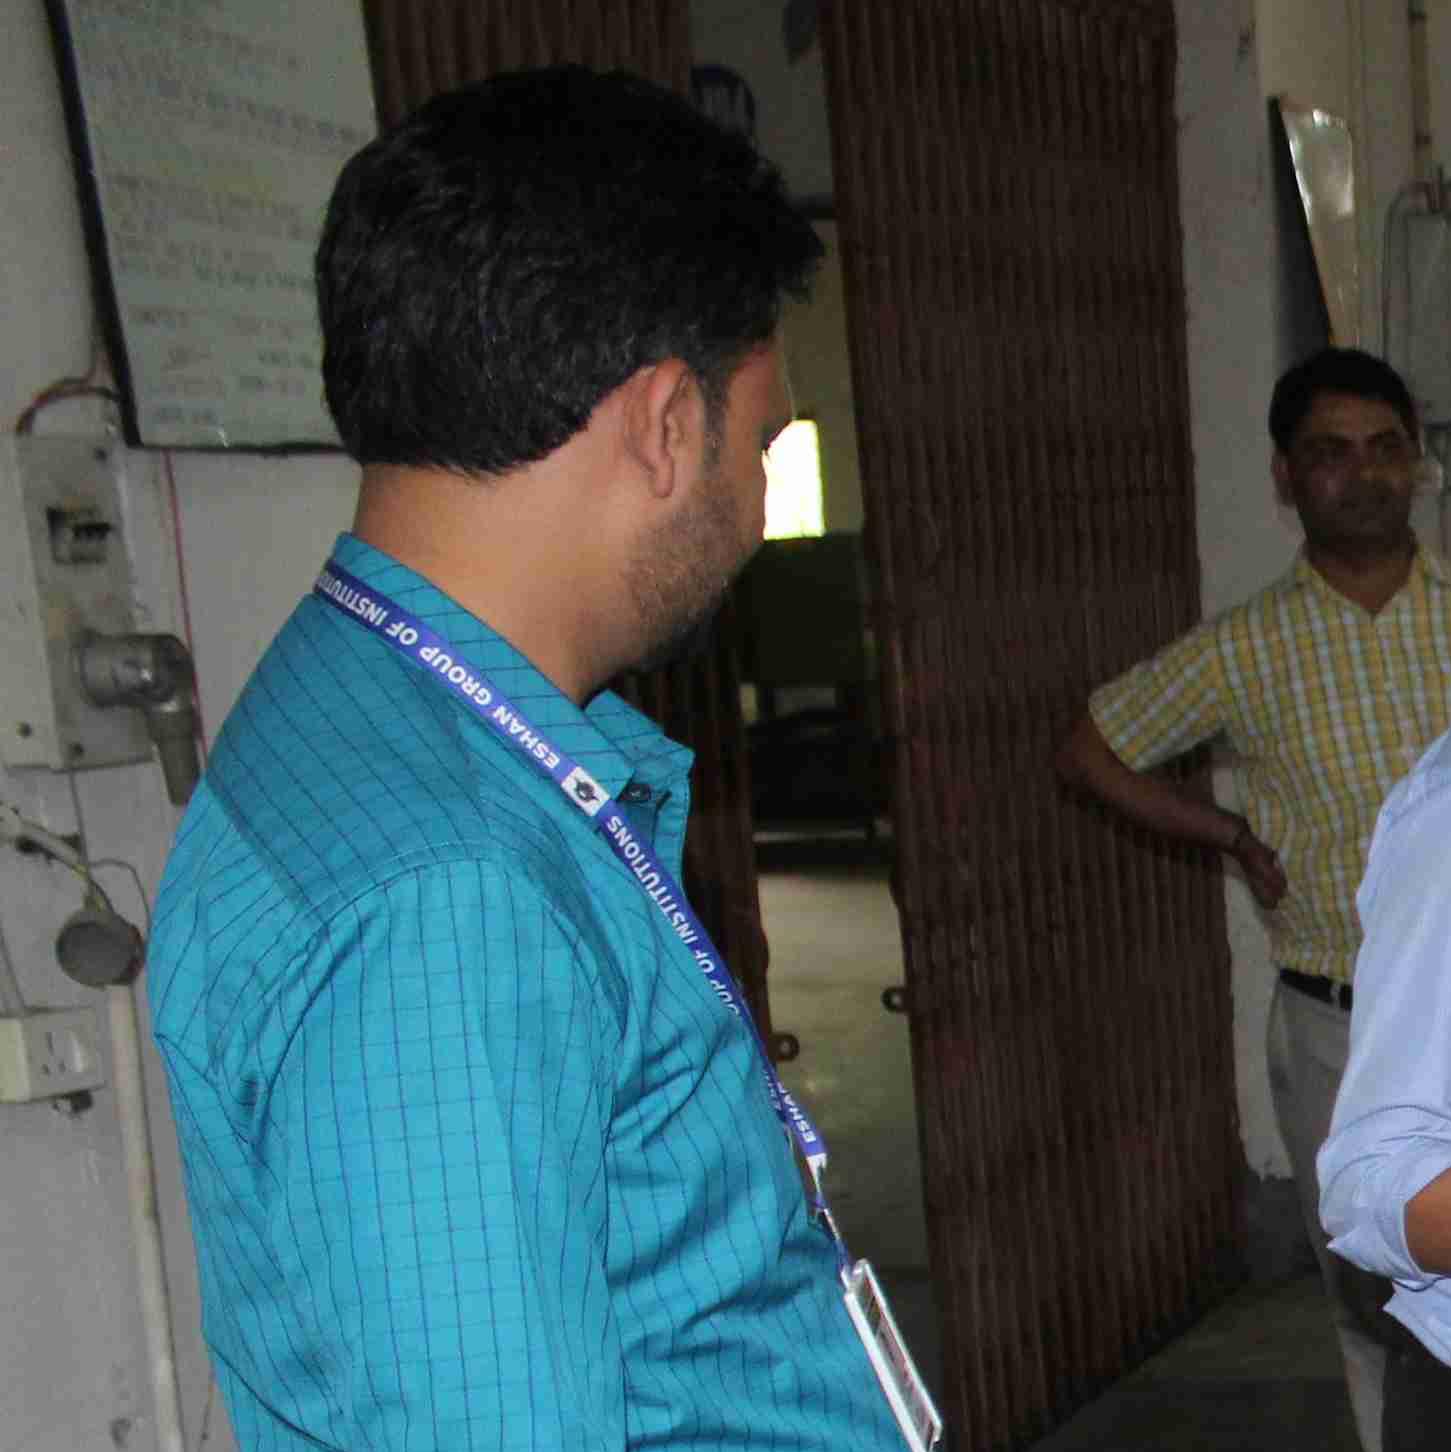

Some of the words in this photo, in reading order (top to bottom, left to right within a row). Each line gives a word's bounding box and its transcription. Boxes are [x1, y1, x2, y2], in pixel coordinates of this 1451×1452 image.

[385, 620, 418, 646] OF
[418, 645, 493, 706] GROUP
[493, 704, 561, 769] ESHAN
[606, 815, 698, 945] INSTITUTIONS
